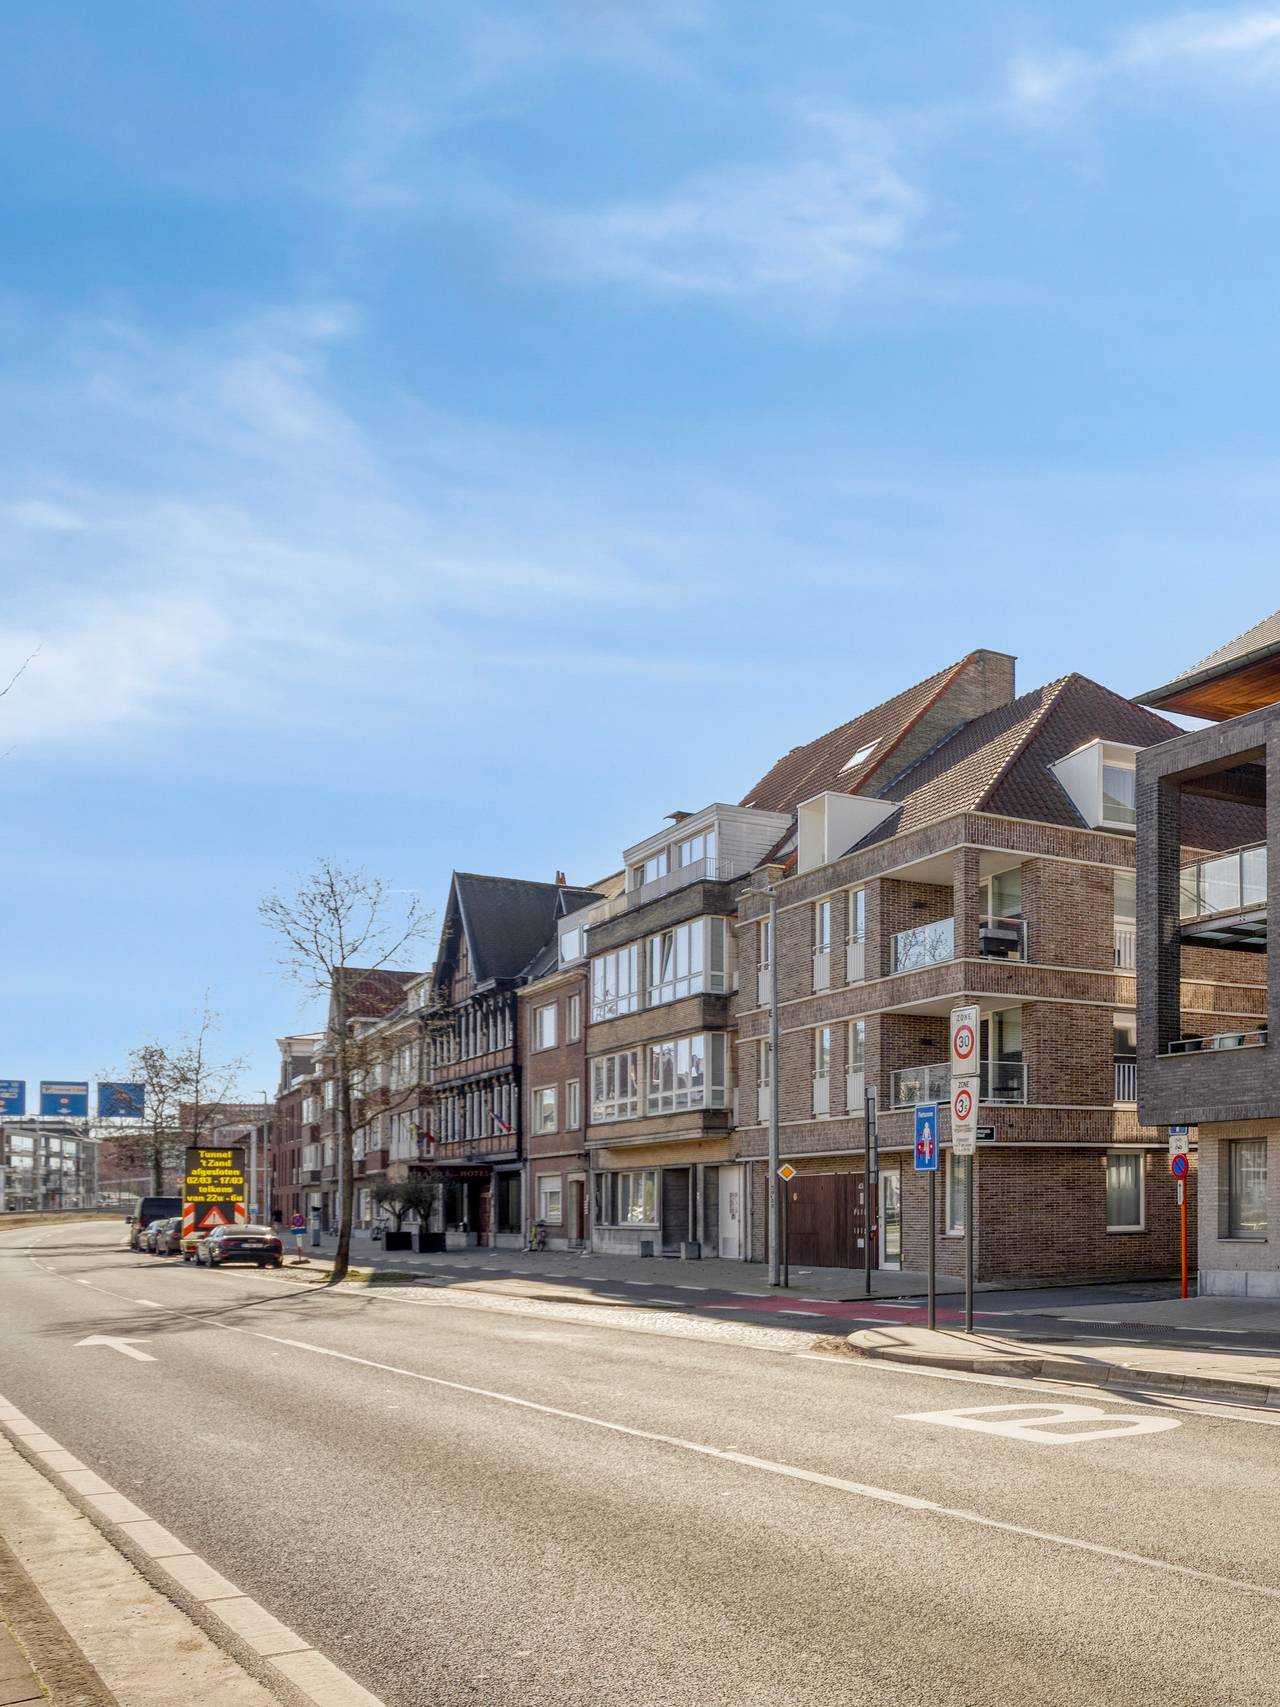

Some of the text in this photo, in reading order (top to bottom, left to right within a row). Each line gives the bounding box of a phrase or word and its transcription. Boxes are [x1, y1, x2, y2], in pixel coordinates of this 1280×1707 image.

[957, 1013, 972, 1021] ZONE
[958, 1035, 970, 1049] 30
[199, 1150, 232, 1158] Tunnel
[191, 1168, 241, 1176] afgesloten
[198, 1185, 233, 1193] telkens
[206, 1194, 224, 1202] 22u
